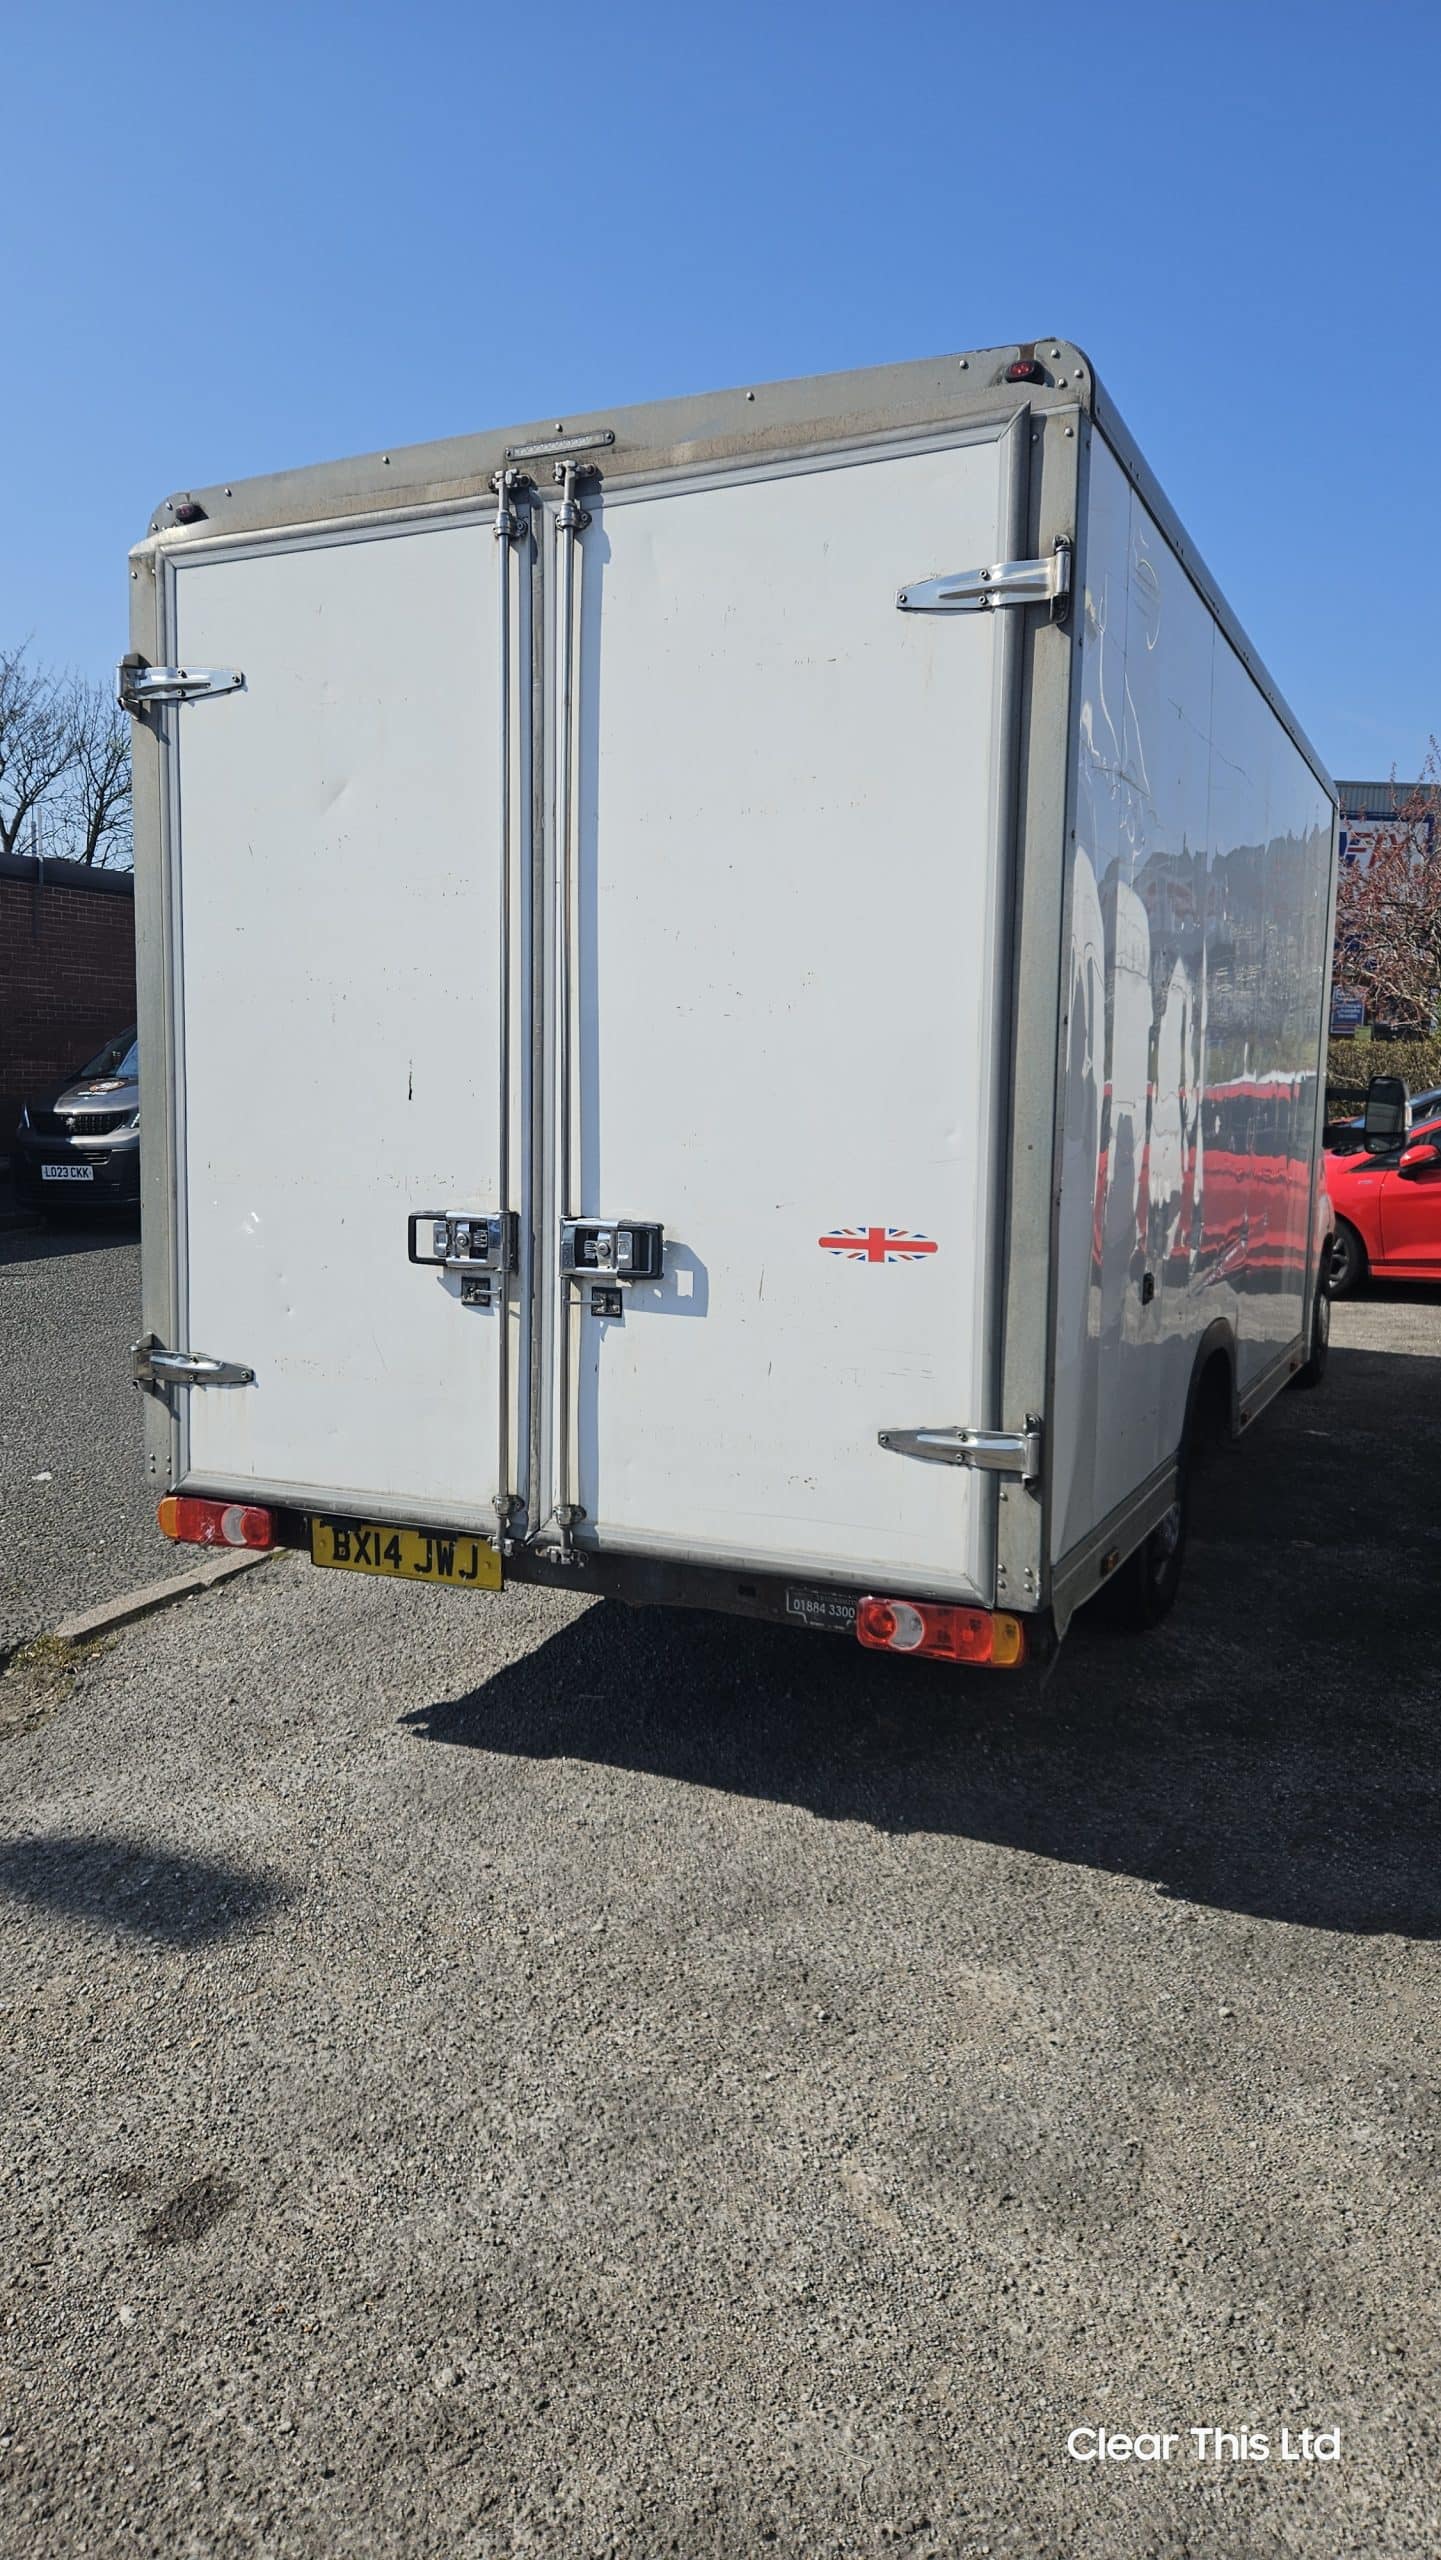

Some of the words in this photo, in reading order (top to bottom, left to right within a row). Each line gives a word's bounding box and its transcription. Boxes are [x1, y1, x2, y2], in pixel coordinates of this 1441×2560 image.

[71, 1167, 89, 1178] CKK
[333, 1527, 402, 1569] BX14
[414, 1539, 478, 1579] JWJ
[793, 1599, 826, 1614] 01884
